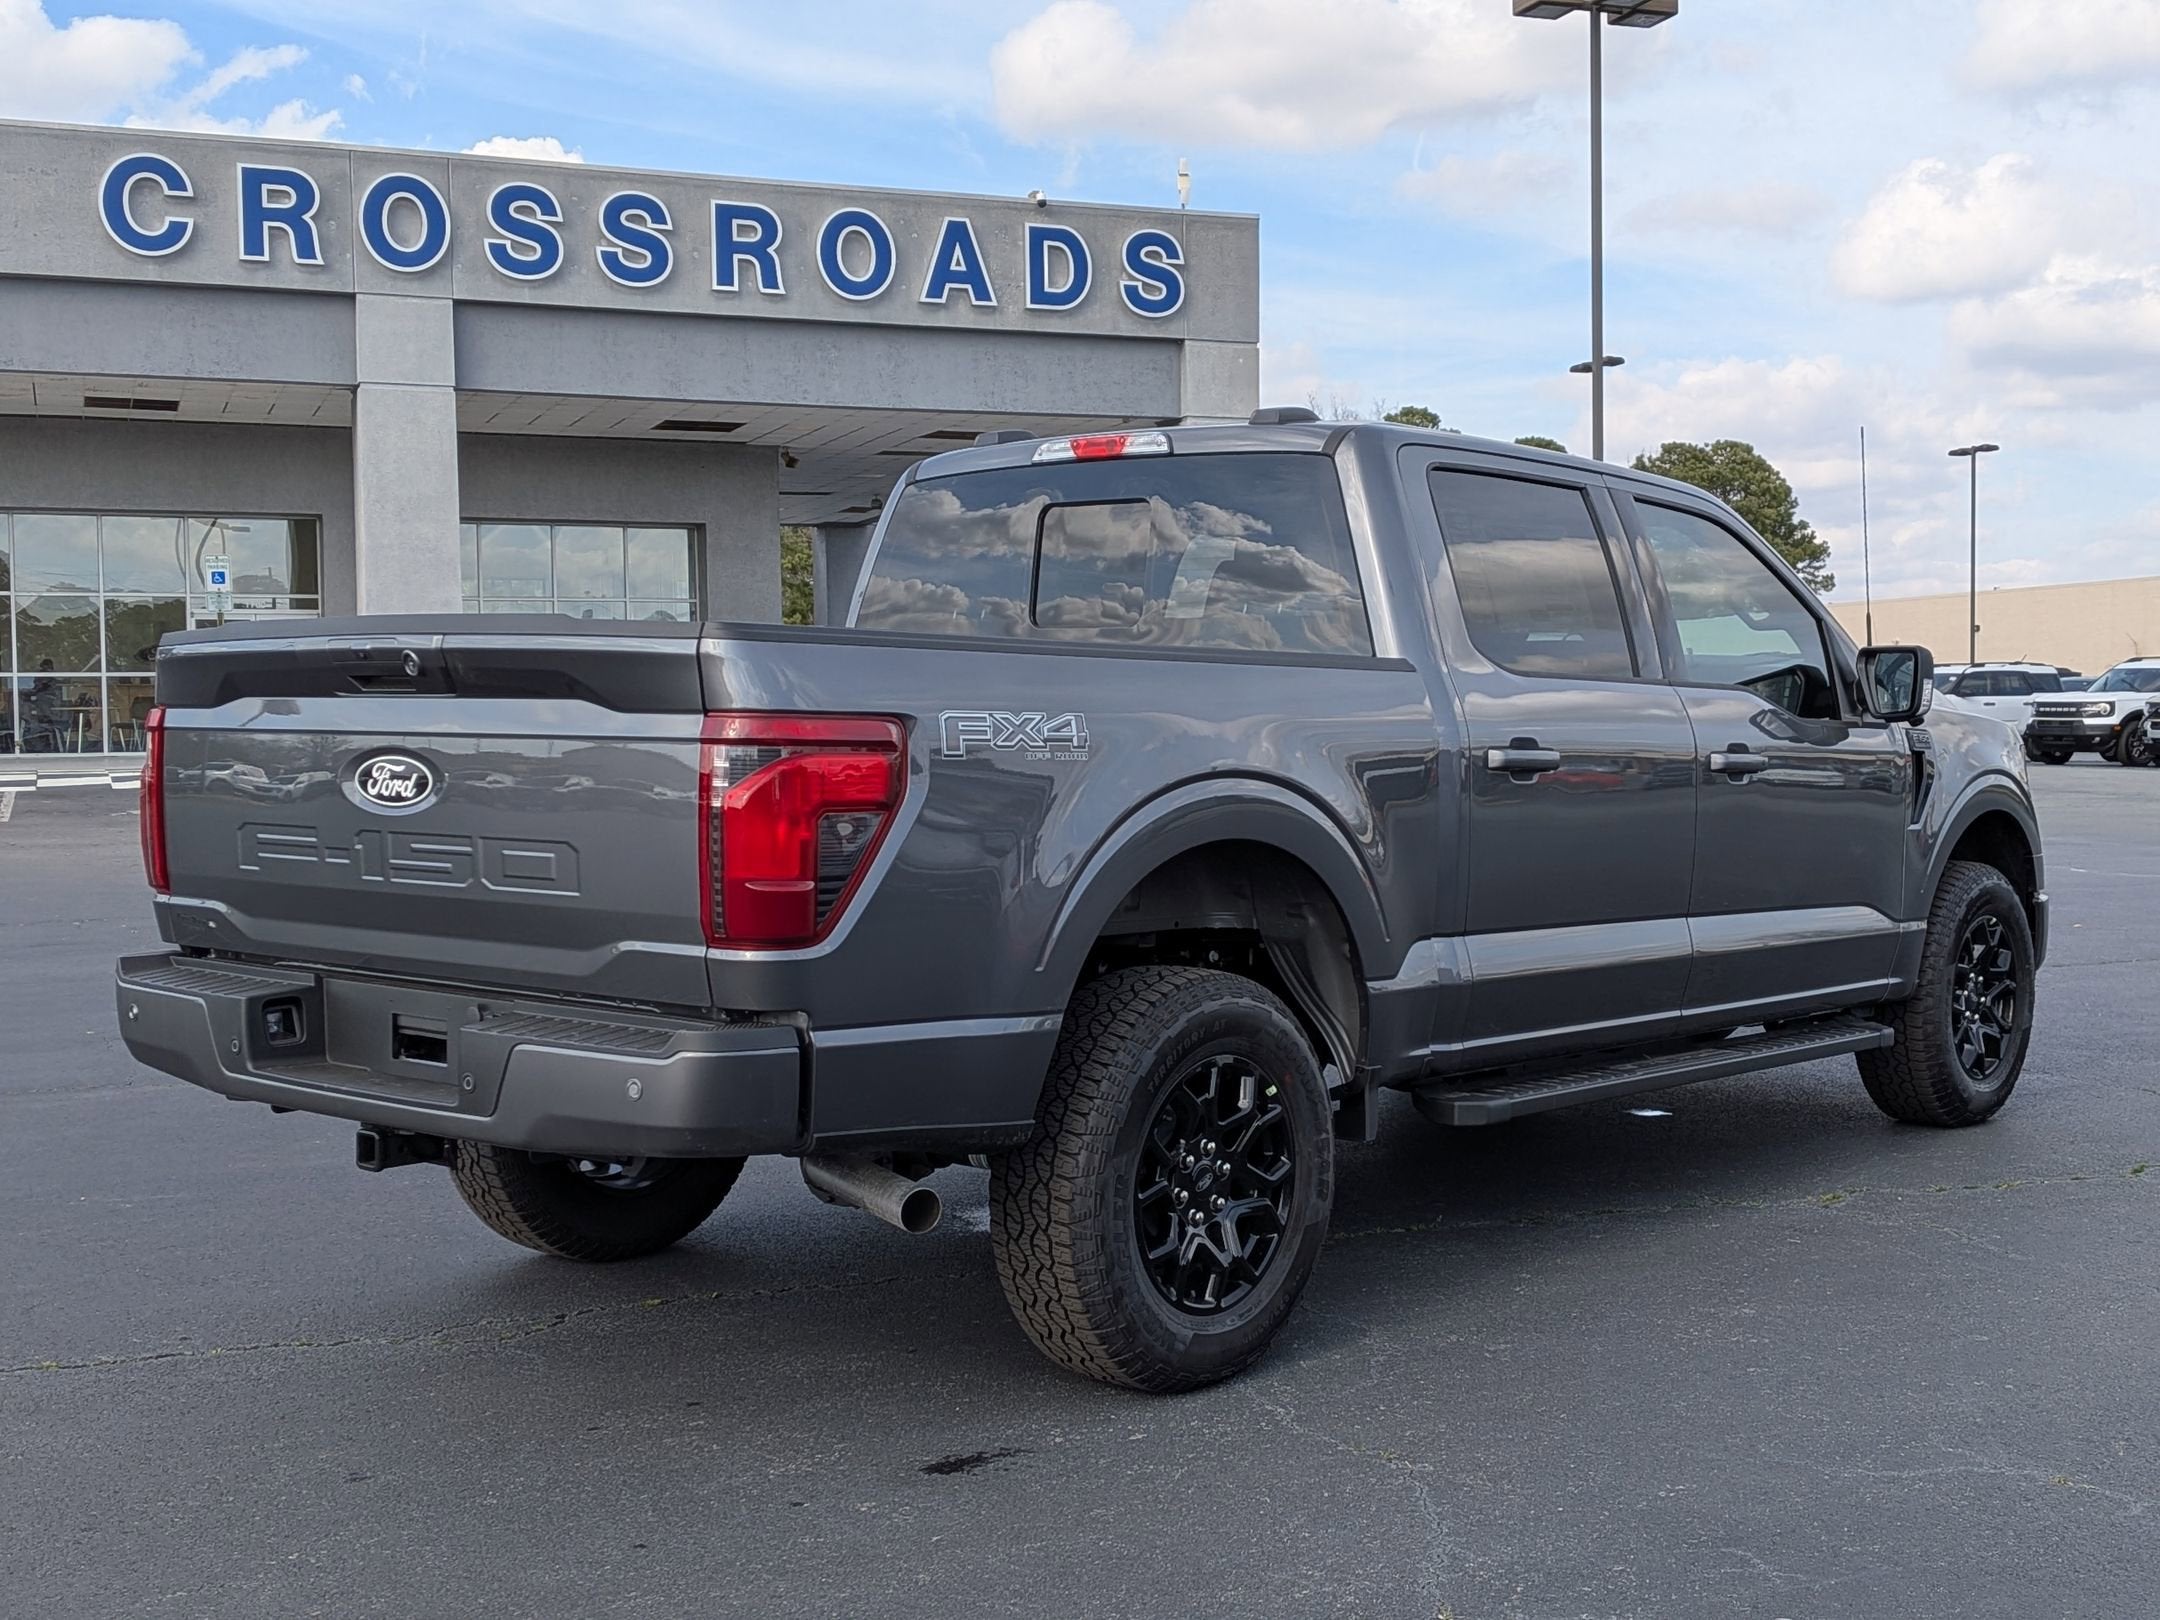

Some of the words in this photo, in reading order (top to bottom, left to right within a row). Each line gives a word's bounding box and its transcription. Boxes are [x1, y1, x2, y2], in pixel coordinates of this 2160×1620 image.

[98, 152, 1185, 318] CROSSROADS
[939, 710, 1089, 760] FX4
[367, 762, 418, 797] Ford
[236, 822, 581, 897] F-150
[1147, 1025, 1208, 1094] TERRITORY
